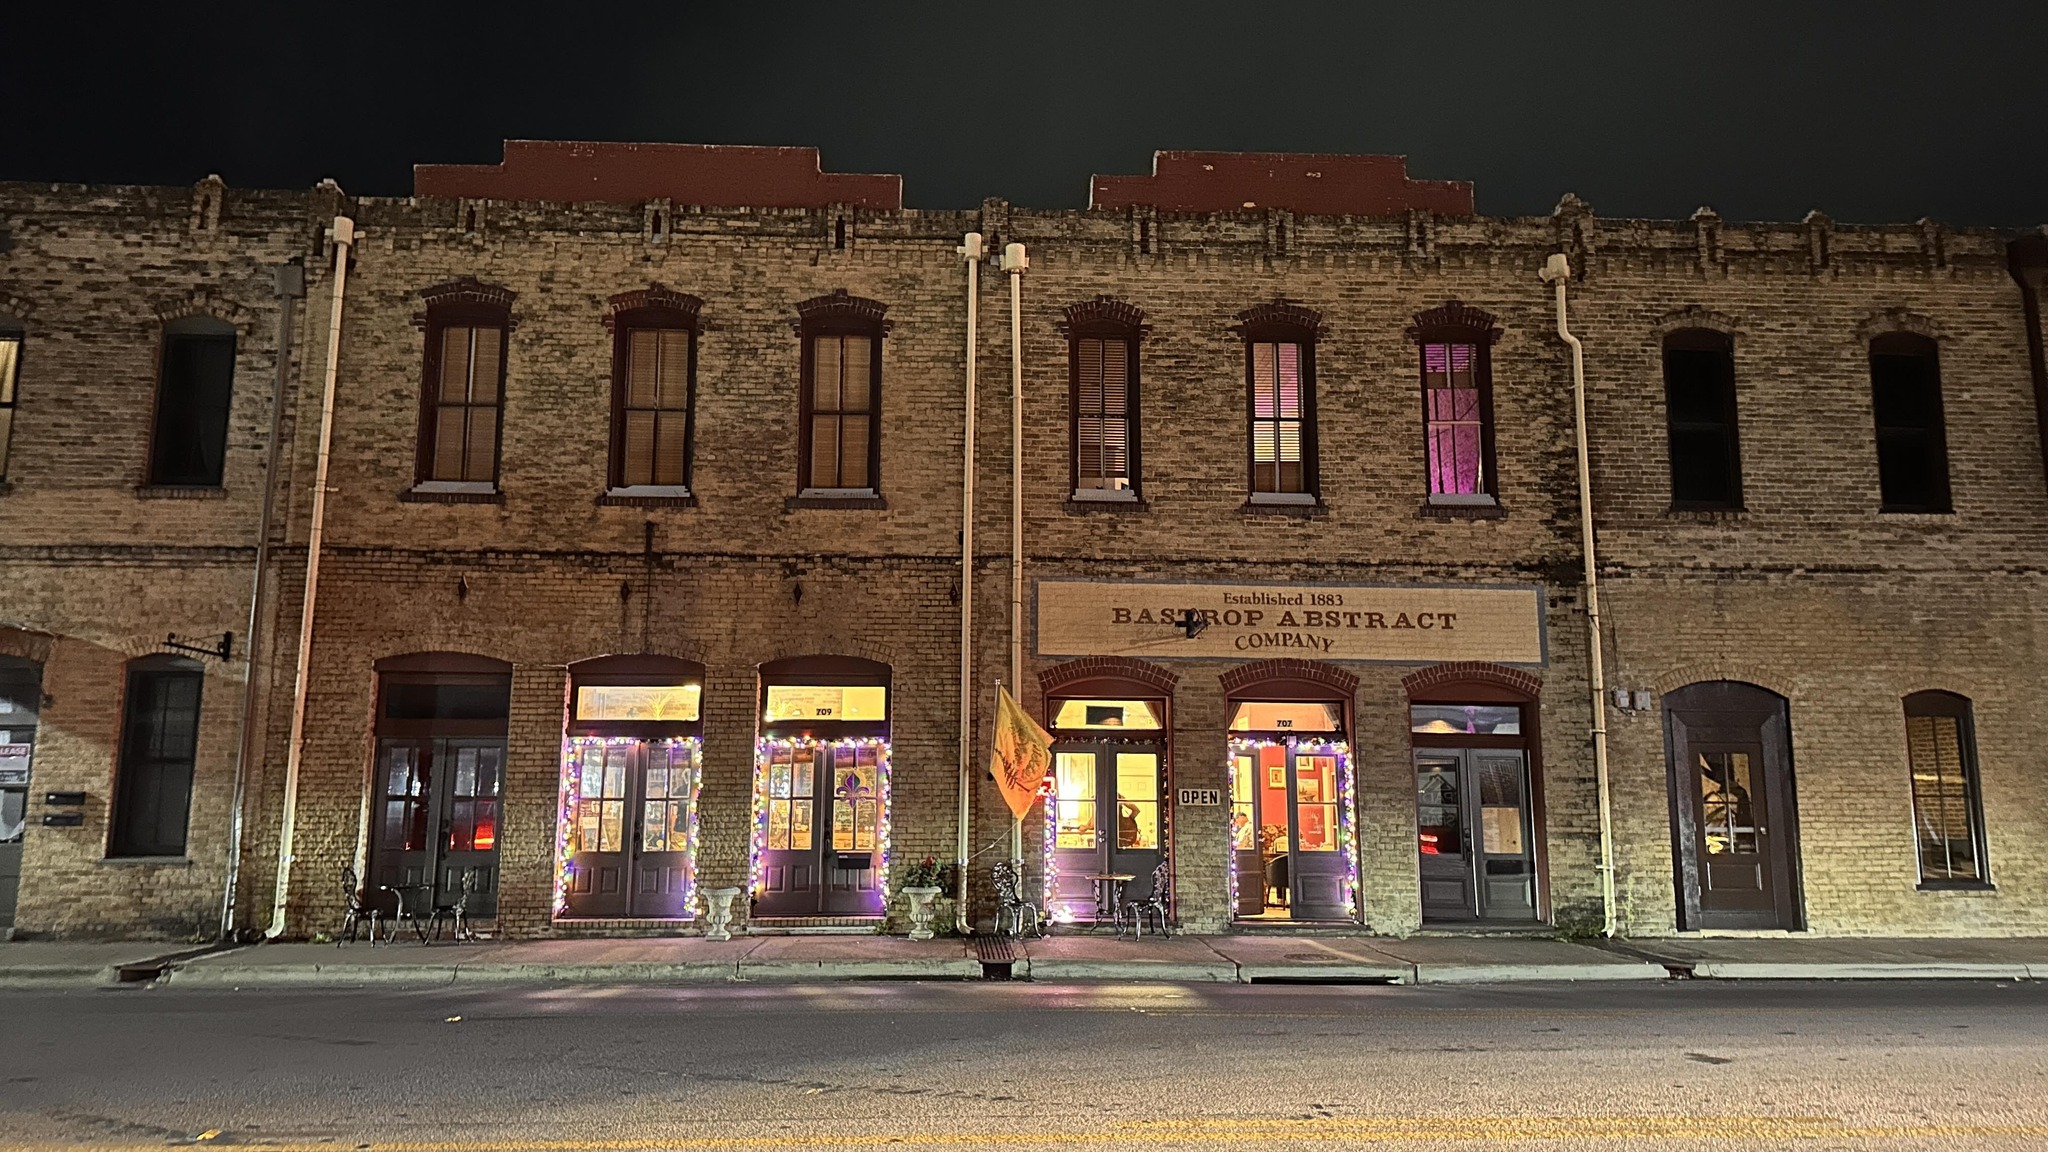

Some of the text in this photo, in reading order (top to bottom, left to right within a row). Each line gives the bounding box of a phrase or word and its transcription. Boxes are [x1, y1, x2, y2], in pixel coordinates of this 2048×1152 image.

[1223, 592, 1344, 606] Established 1883
[1276, 610, 1457, 630] ABSTRACT
[1235, 632, 1335, 653] COMPANY
[816, 708, 832, 716] 709
[1181, 790, 1218, 804] OPEN
